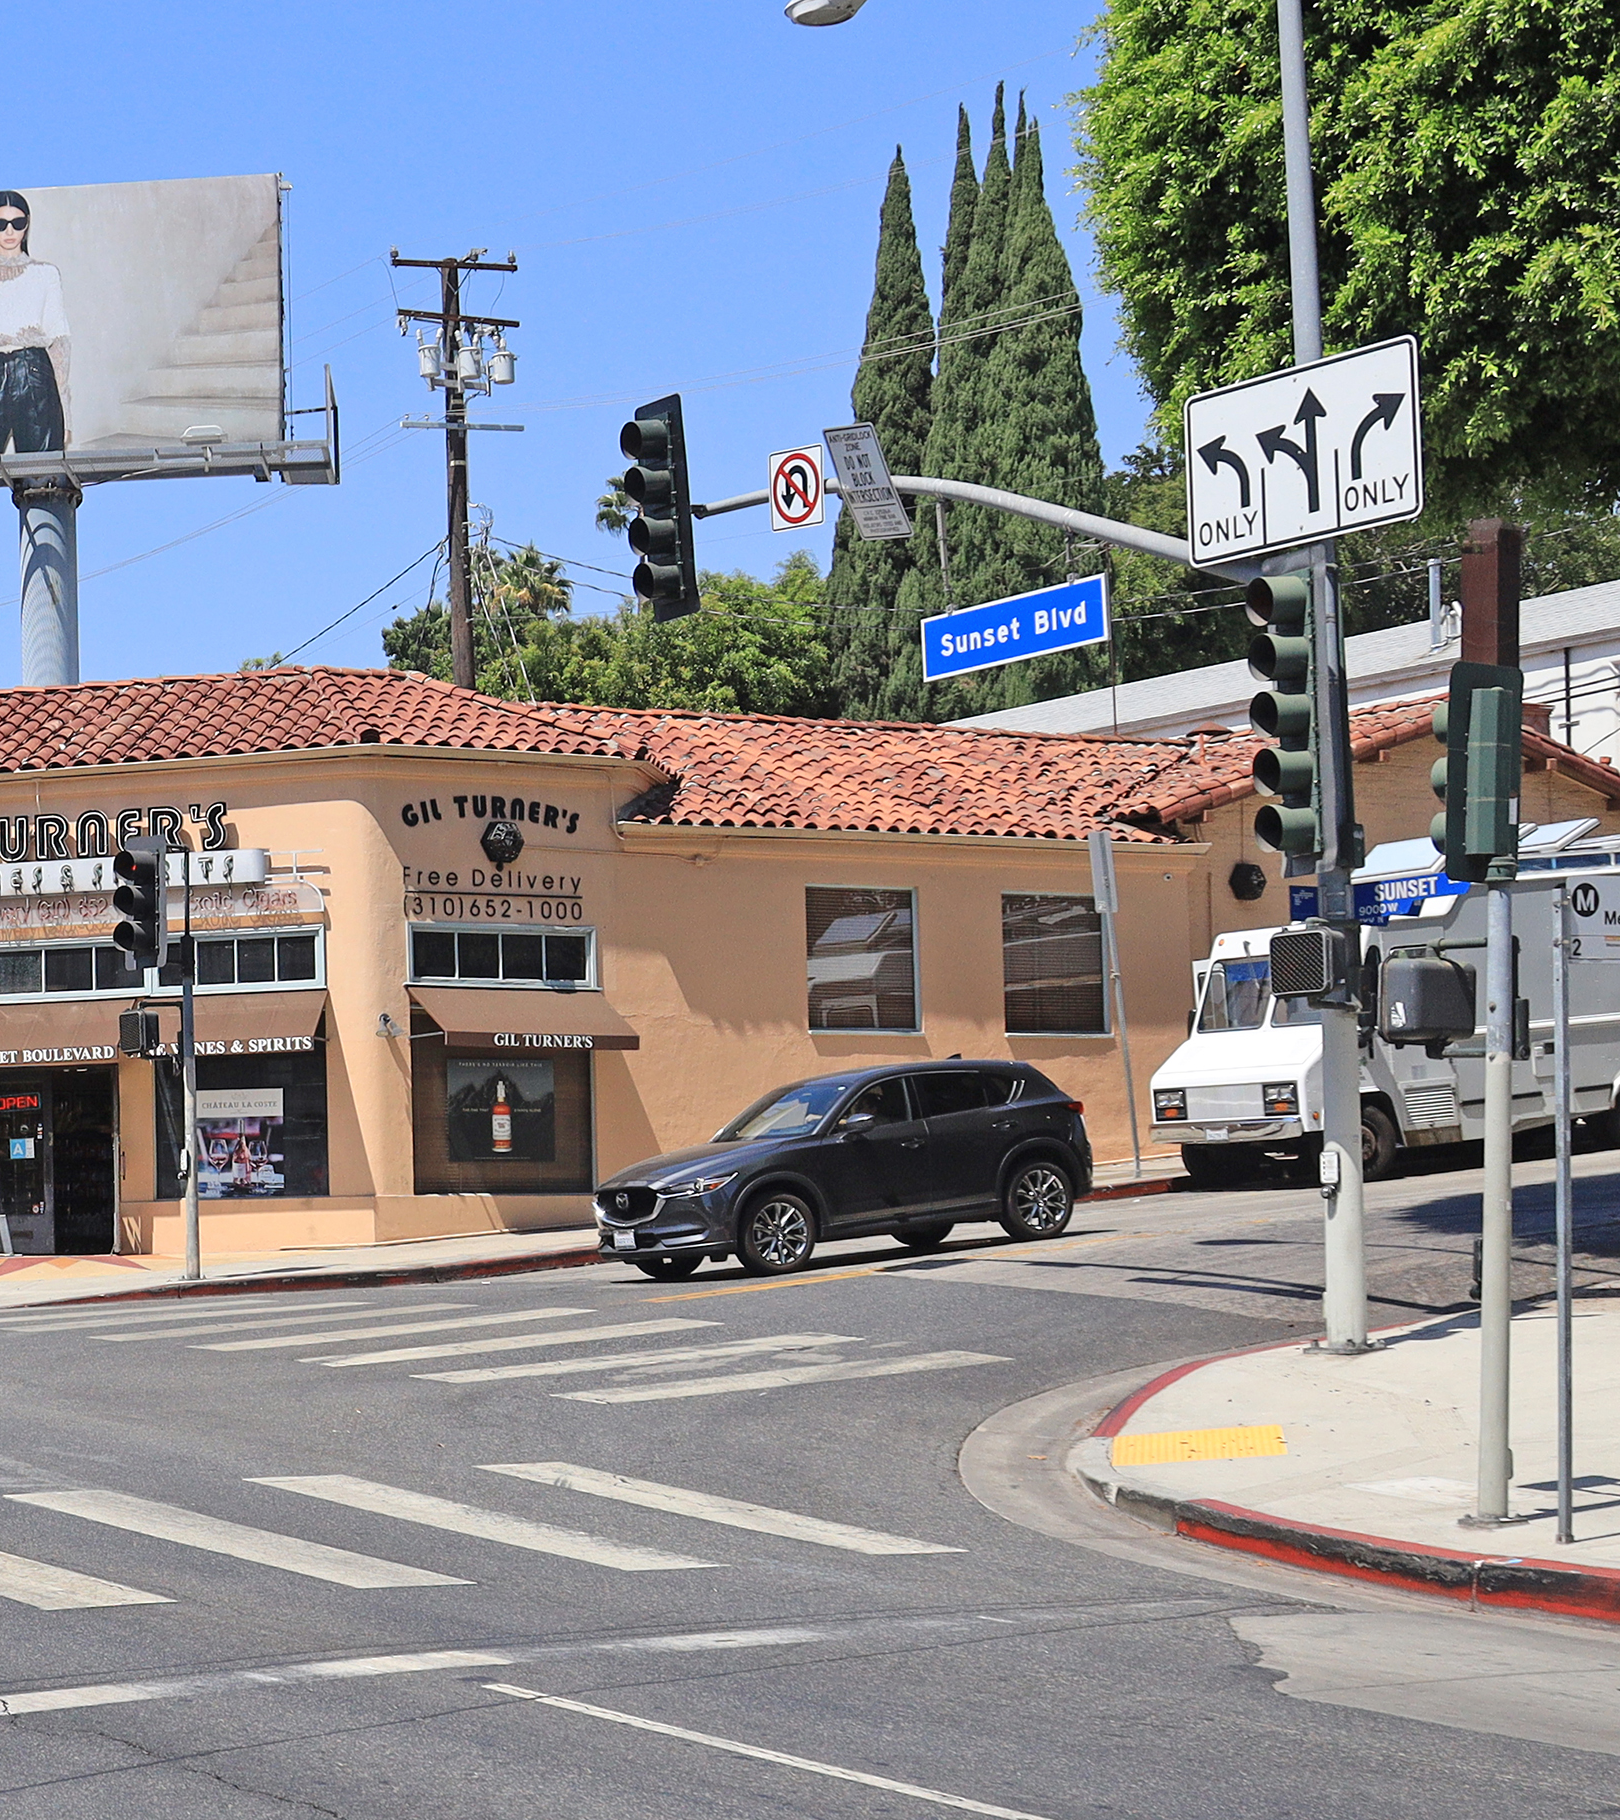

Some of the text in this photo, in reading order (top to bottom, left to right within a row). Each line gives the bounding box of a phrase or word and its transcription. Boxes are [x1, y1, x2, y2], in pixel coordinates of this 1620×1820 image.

[829, 430, 872, 444] ANTI-GRIDLOCK
[845, 442, 861, 452] ZONE
[844, 453, 872, 471] DO NOT
[851, 471, 876, 487] BLOCK
[846, 487, 895, 504] INTERSECTION
[1344, 472, 1409, 512] ONLY
[1199, 510, 1258, 547] ONLY
[940, 600, 1087, 657] Sunset Blvd
[401, 795, 580, 834] GIL TURNER'S
[91, 855, 235, 892] SITS
[403, 866, 581, 894] Free Delivery
[242, 887, 298, 909] Cigars
[1374, 876, 1438, 902] SUNSET
[403, 895, 582, 920] (310)652-1000
[1572, 938, 1582, 956] 2
[22, 1045, 115, 1063] BOULEVARD
[170, 1041, 226, 1056] NES
[230, 1039, 244, 1053] &
[248, 1036, 313, 1052] SPIRITS
[494, 1033, 593, 1048] GIL TURNER'S
[202, 1100, 239, 1109] CHÂTEAU
[12, 1142, 24, 1155] A
